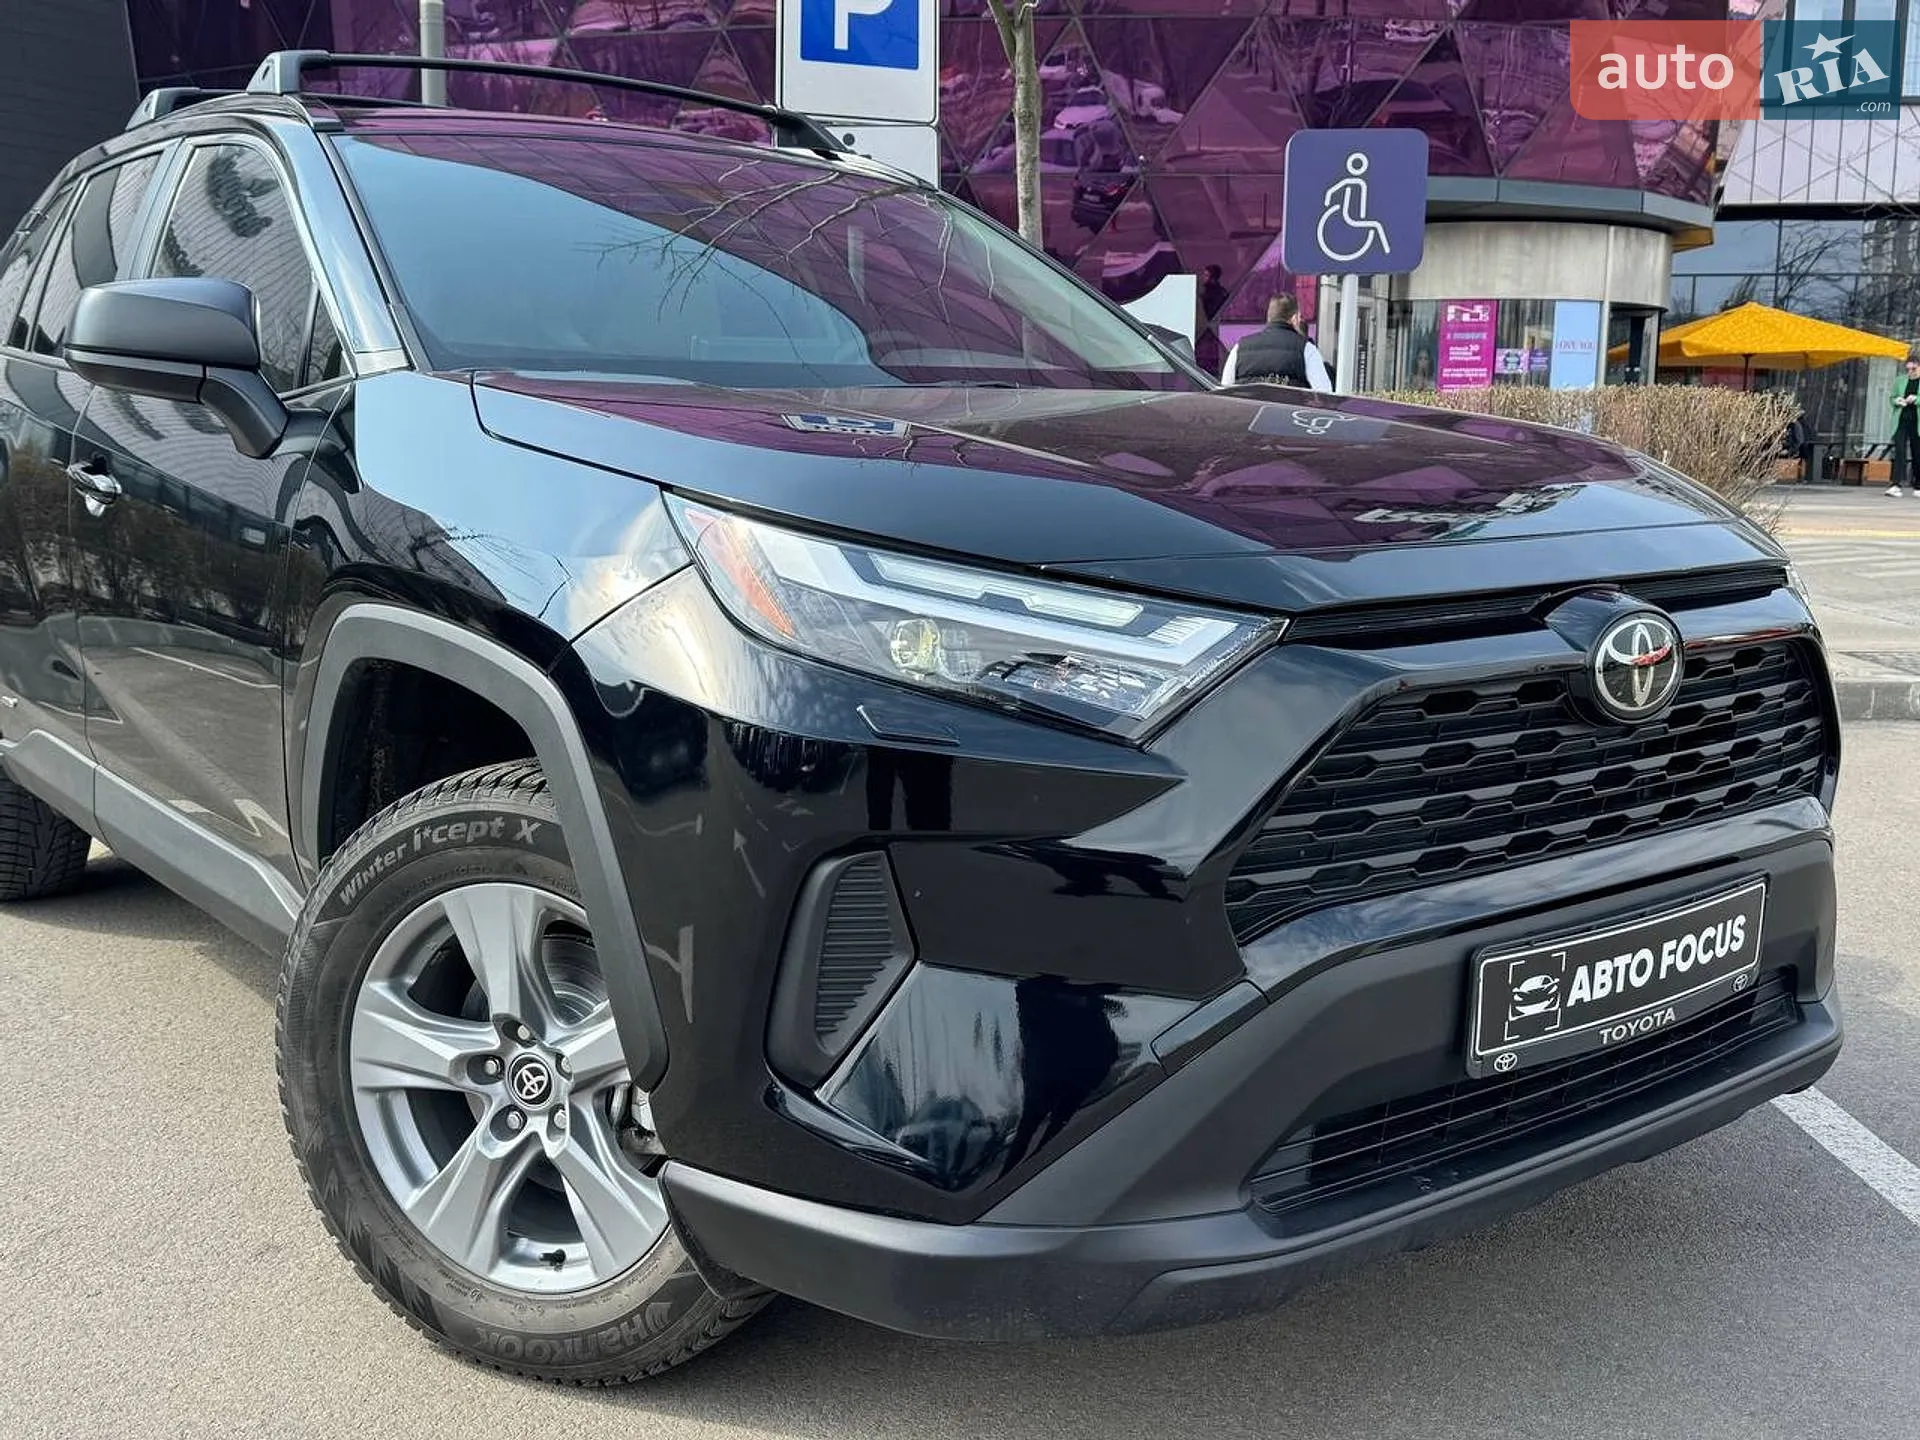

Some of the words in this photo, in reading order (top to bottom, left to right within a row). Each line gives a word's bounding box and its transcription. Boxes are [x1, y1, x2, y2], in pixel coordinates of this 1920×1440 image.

[340, 842, 408, 906] Winter
[512, 818, 541, 845] X
[1659, 914, 1747, 979] FOCUS
[1600, 1007, 1676, 1045] TOYOTA
